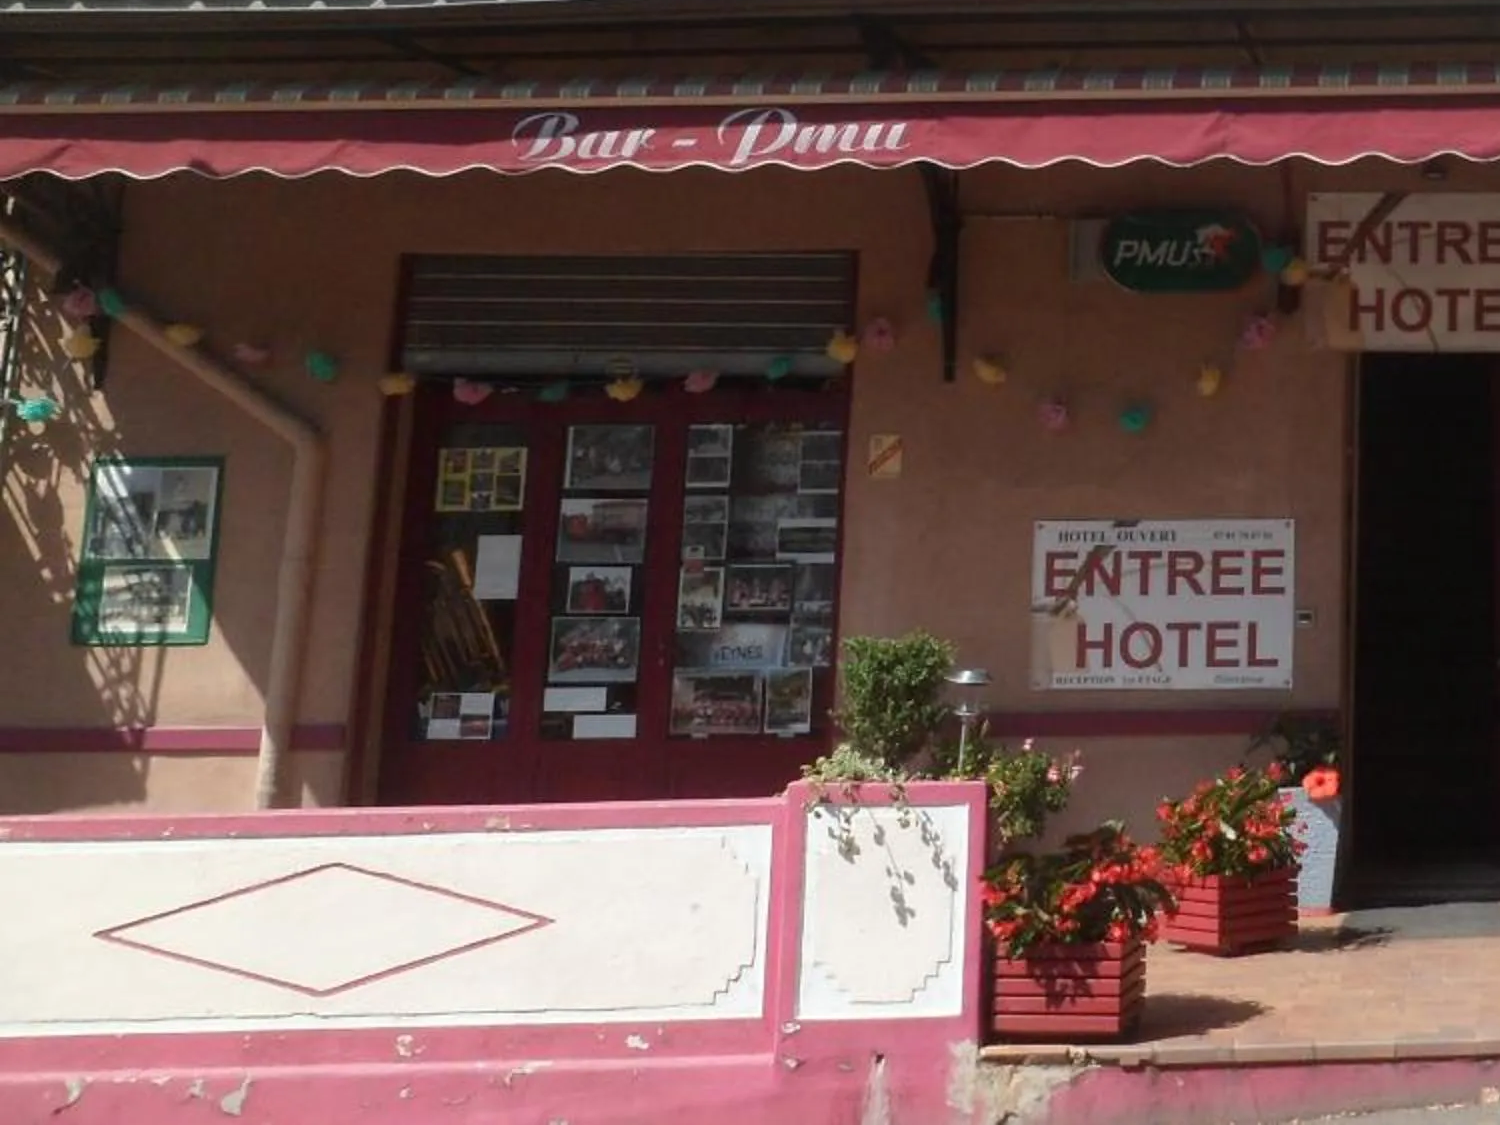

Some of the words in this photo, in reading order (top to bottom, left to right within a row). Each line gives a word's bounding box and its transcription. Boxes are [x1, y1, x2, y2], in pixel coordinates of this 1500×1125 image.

[511, 111, 656, 162] Bar
[716, 107, 911, 166] Pmu
[1112, 239, 1194, 268] PMU
[1044, 548, 1287, 598] ENTREE
[1075, 620, 1280, 669] HOTEL
